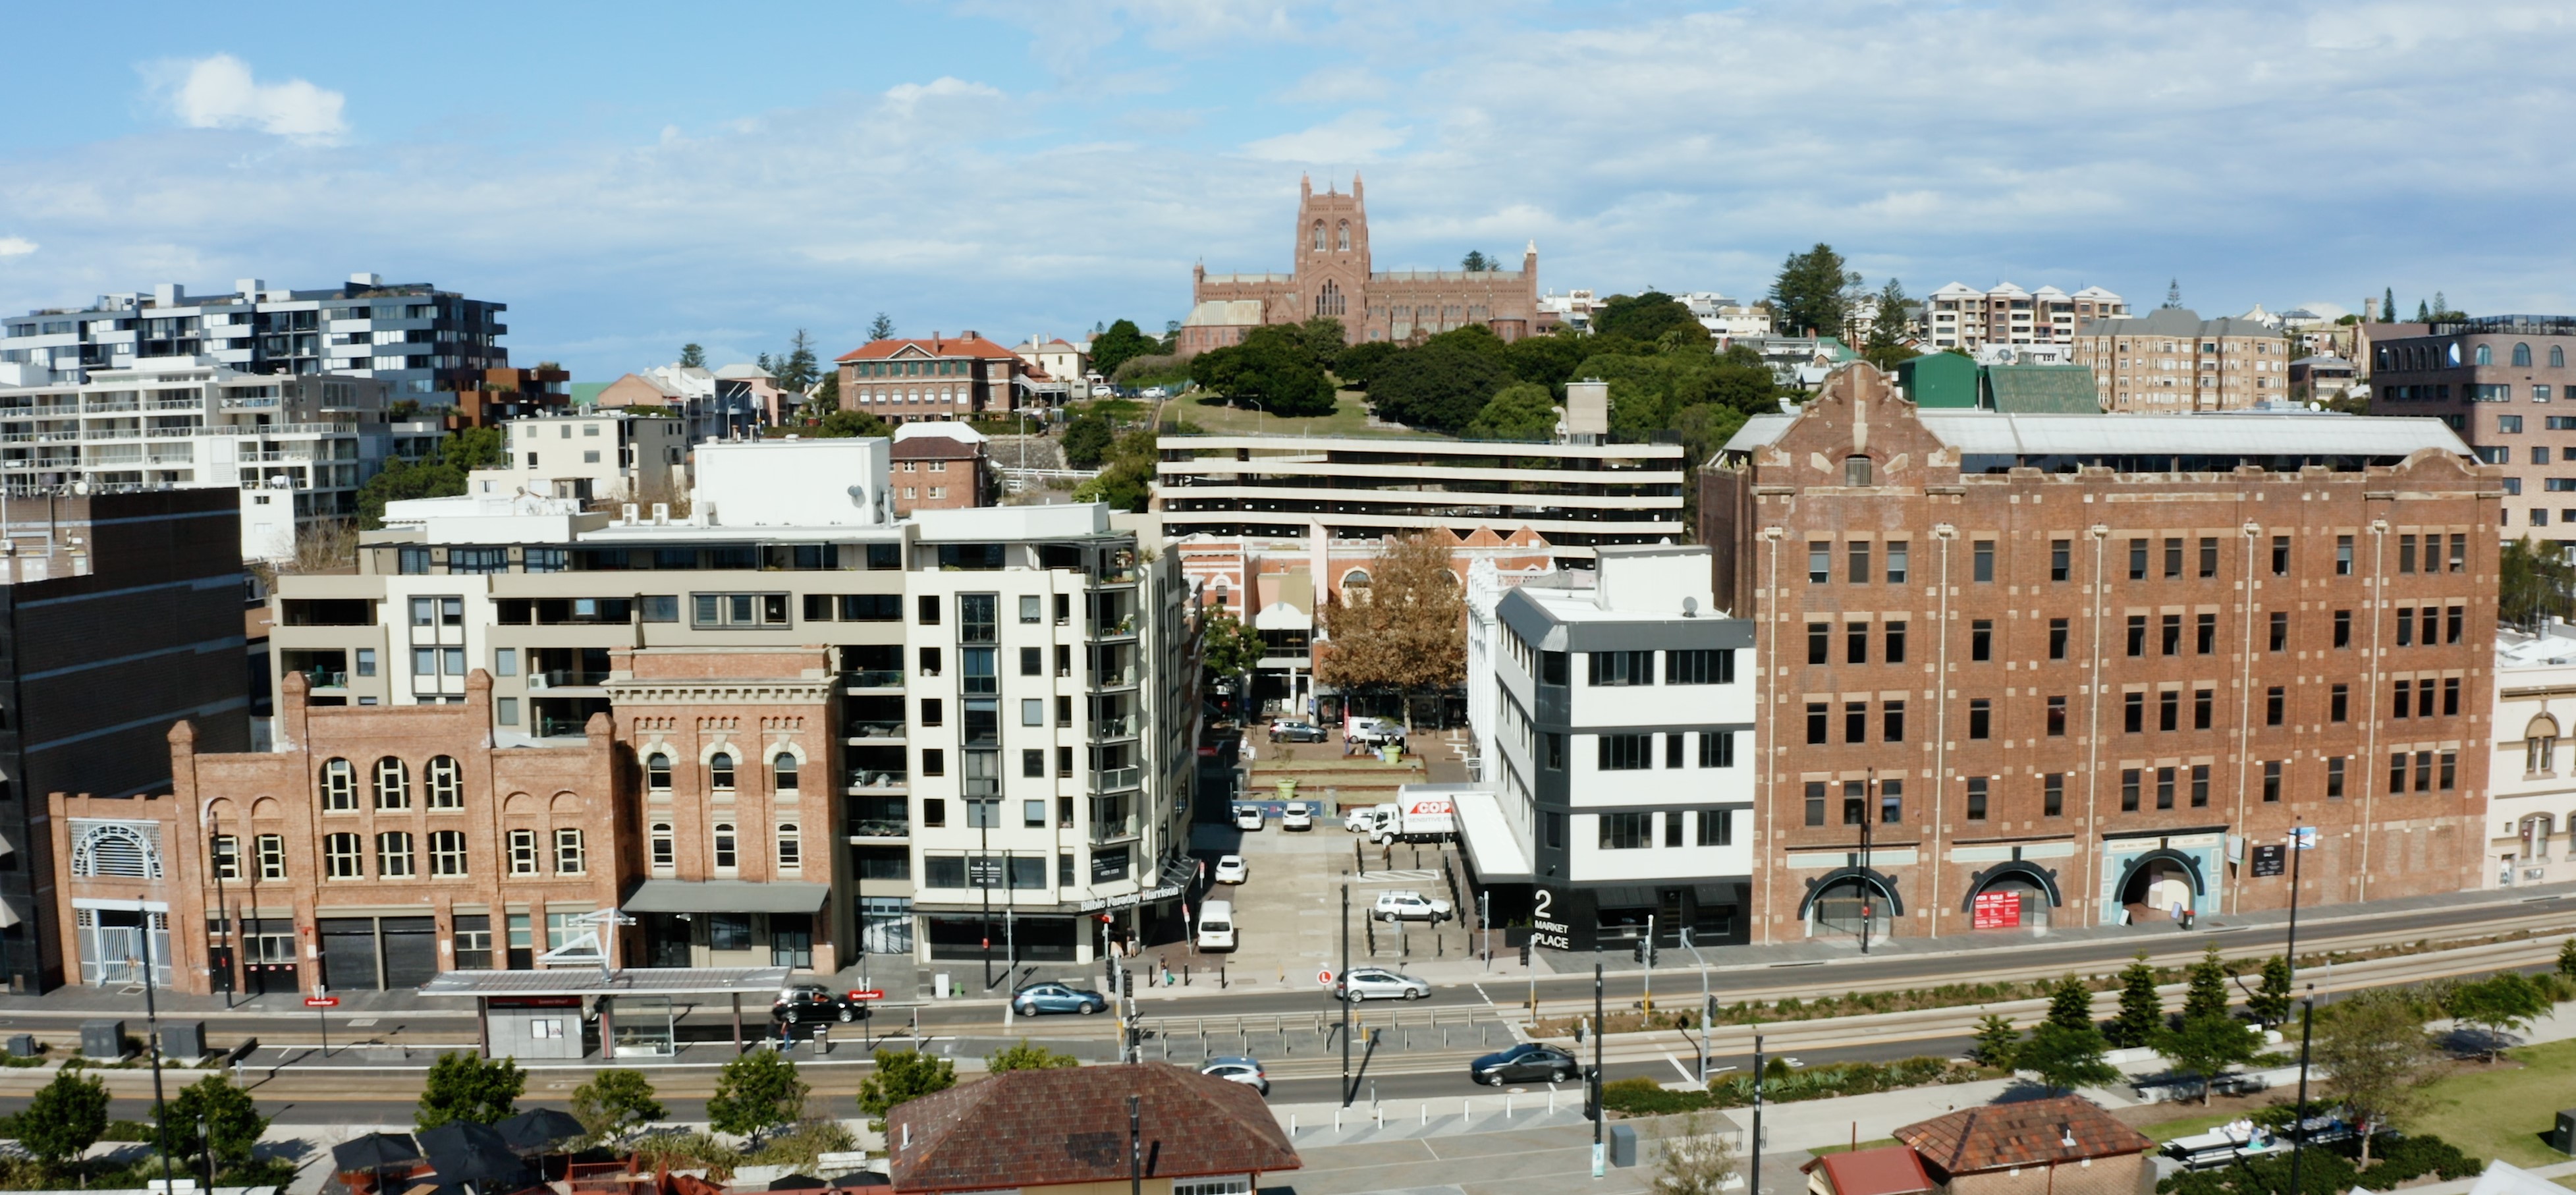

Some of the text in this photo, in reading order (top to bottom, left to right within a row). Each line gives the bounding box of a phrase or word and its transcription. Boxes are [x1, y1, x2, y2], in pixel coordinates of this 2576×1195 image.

[1081, 901, 1105, 911] Bilbie
[1107, 894, 1141, 907] Faraday
[1143, 887, 1178, 901] Harrison
[1535, 889, 1551, 918] 2
[1535, 920, 1568, 933] MARKET
[1535, 932, 1568, 949] PLACE
[1322, 972, 1329, 982] L
